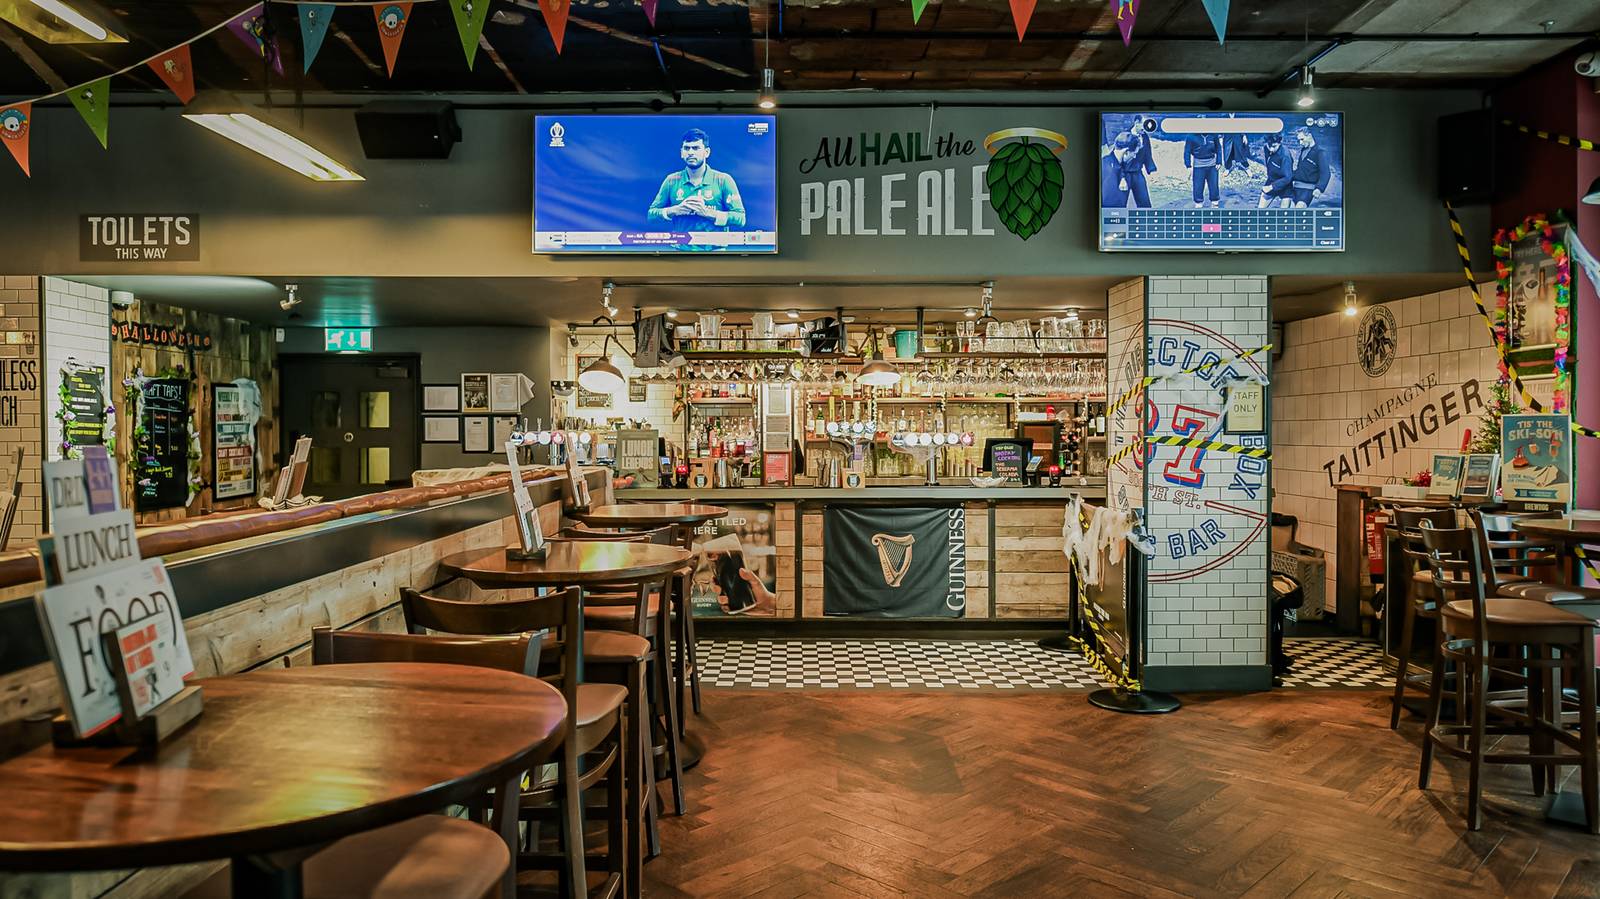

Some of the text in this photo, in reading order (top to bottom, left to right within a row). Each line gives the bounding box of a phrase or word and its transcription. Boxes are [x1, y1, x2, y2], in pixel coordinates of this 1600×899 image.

[800, 132, 976, 174] All HAIL the
[800, 164, 995, 235] PALE ALE
[88, 216, 190, 246] TOILETS
[115, 248, 167, 259] THIS WAY
[0, 360, 37, 391] LESS
[0, 396, 17, 426] CH
[1233, 404, 1258, 413] ONLY
[1346, 372, 1438, 437] CHAMPAGNE
[1323, 378, 1483, 487] TAITTINGER
[1536, 421, 1553, 429] THE
[1173, 489, 1201, 510] ST.
[63, 523, 132, 573] LUNCH
[1168, 519, 1227, 560] BAR
[946, 507, 966, 611] GUINNESS
